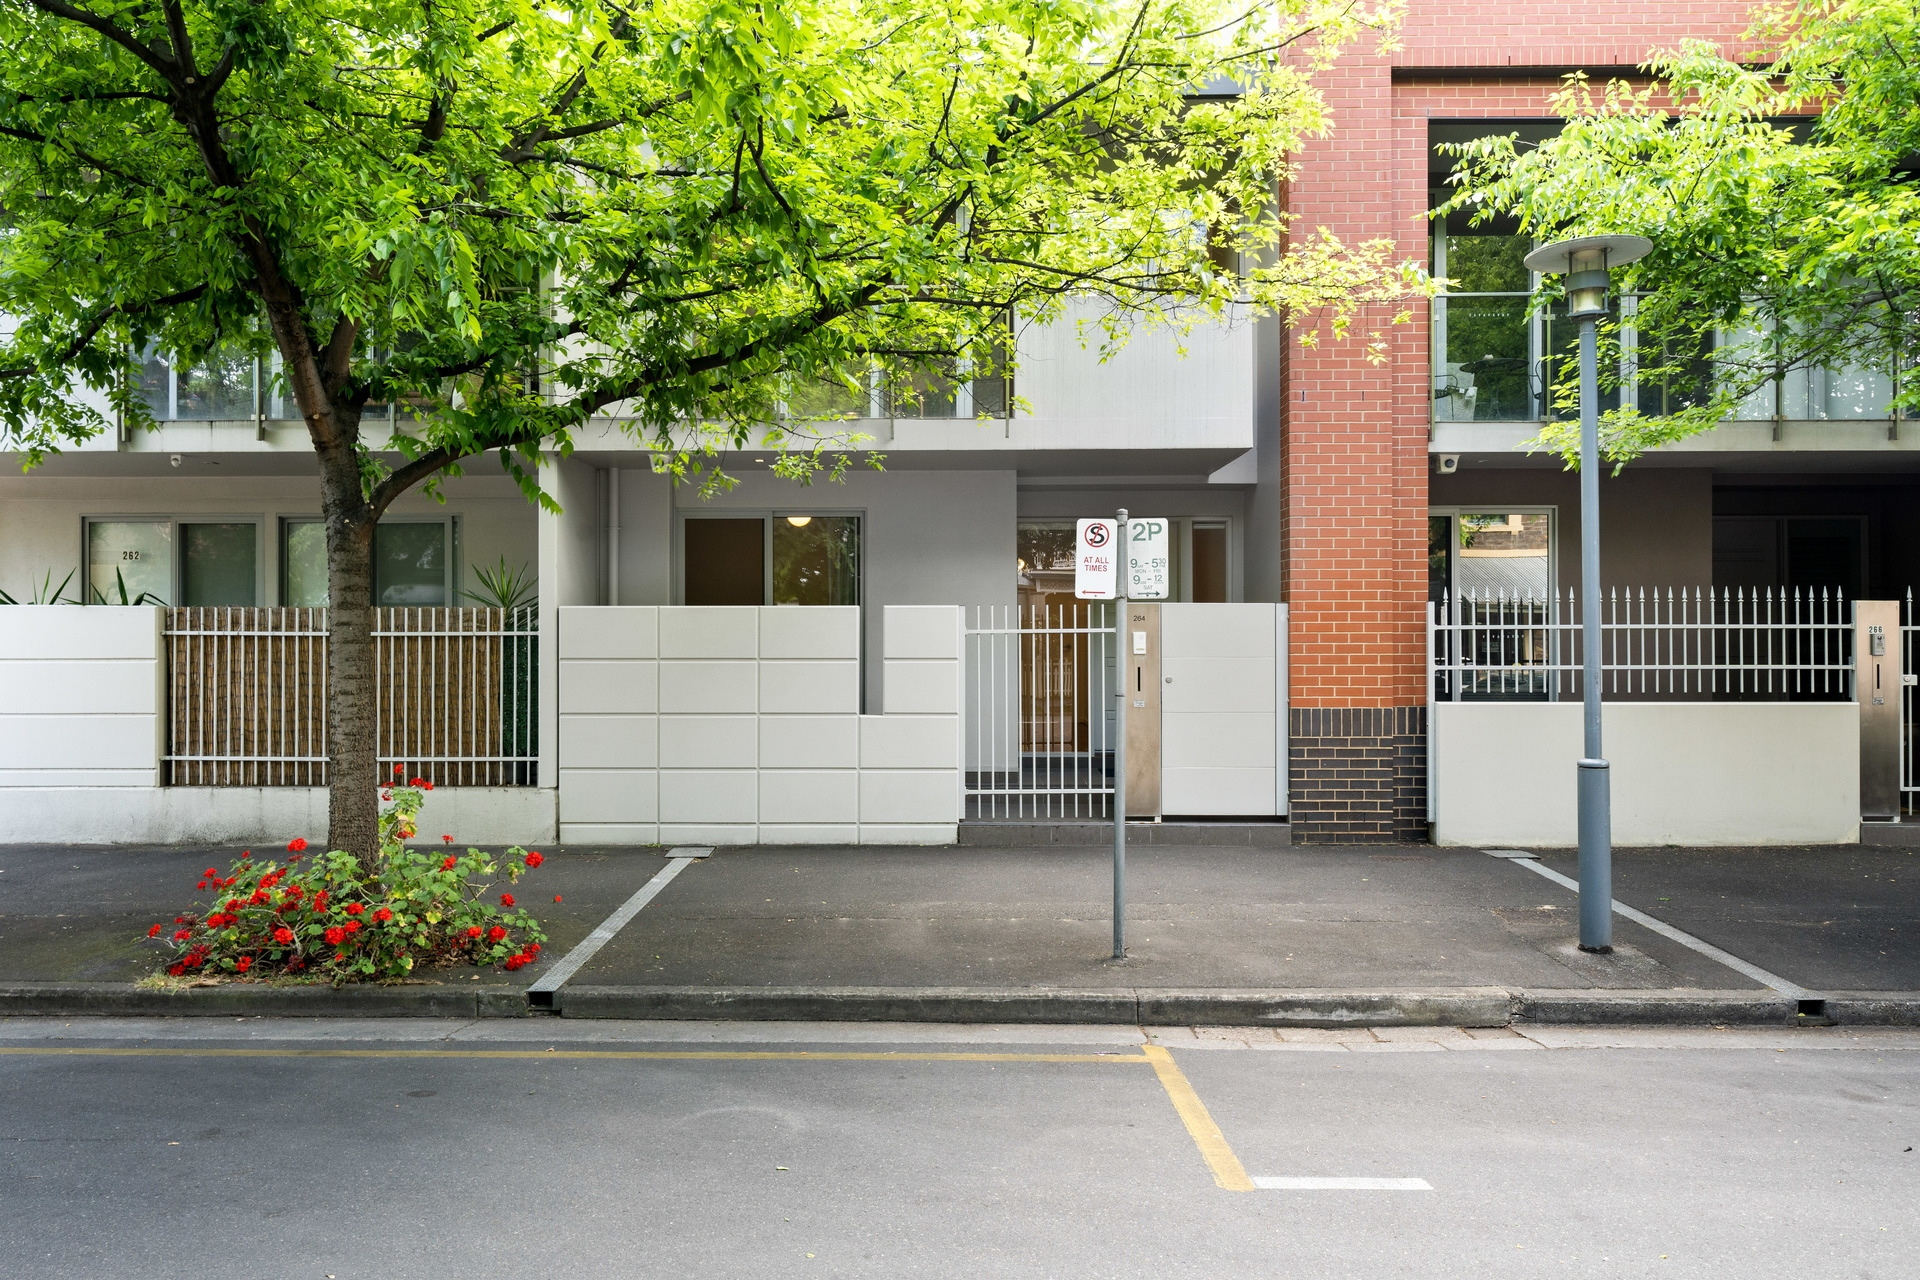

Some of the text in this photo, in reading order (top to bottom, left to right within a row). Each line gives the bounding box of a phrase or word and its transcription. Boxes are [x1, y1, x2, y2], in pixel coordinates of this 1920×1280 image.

[1089, 526, 1105, 544] S
[1132, 522, 1163, 541] 2P
[122, 551, 139, 560] 262
[1094, 556, 1109, 564] ALL
[1085, 564, 1108, 572] TIMES
